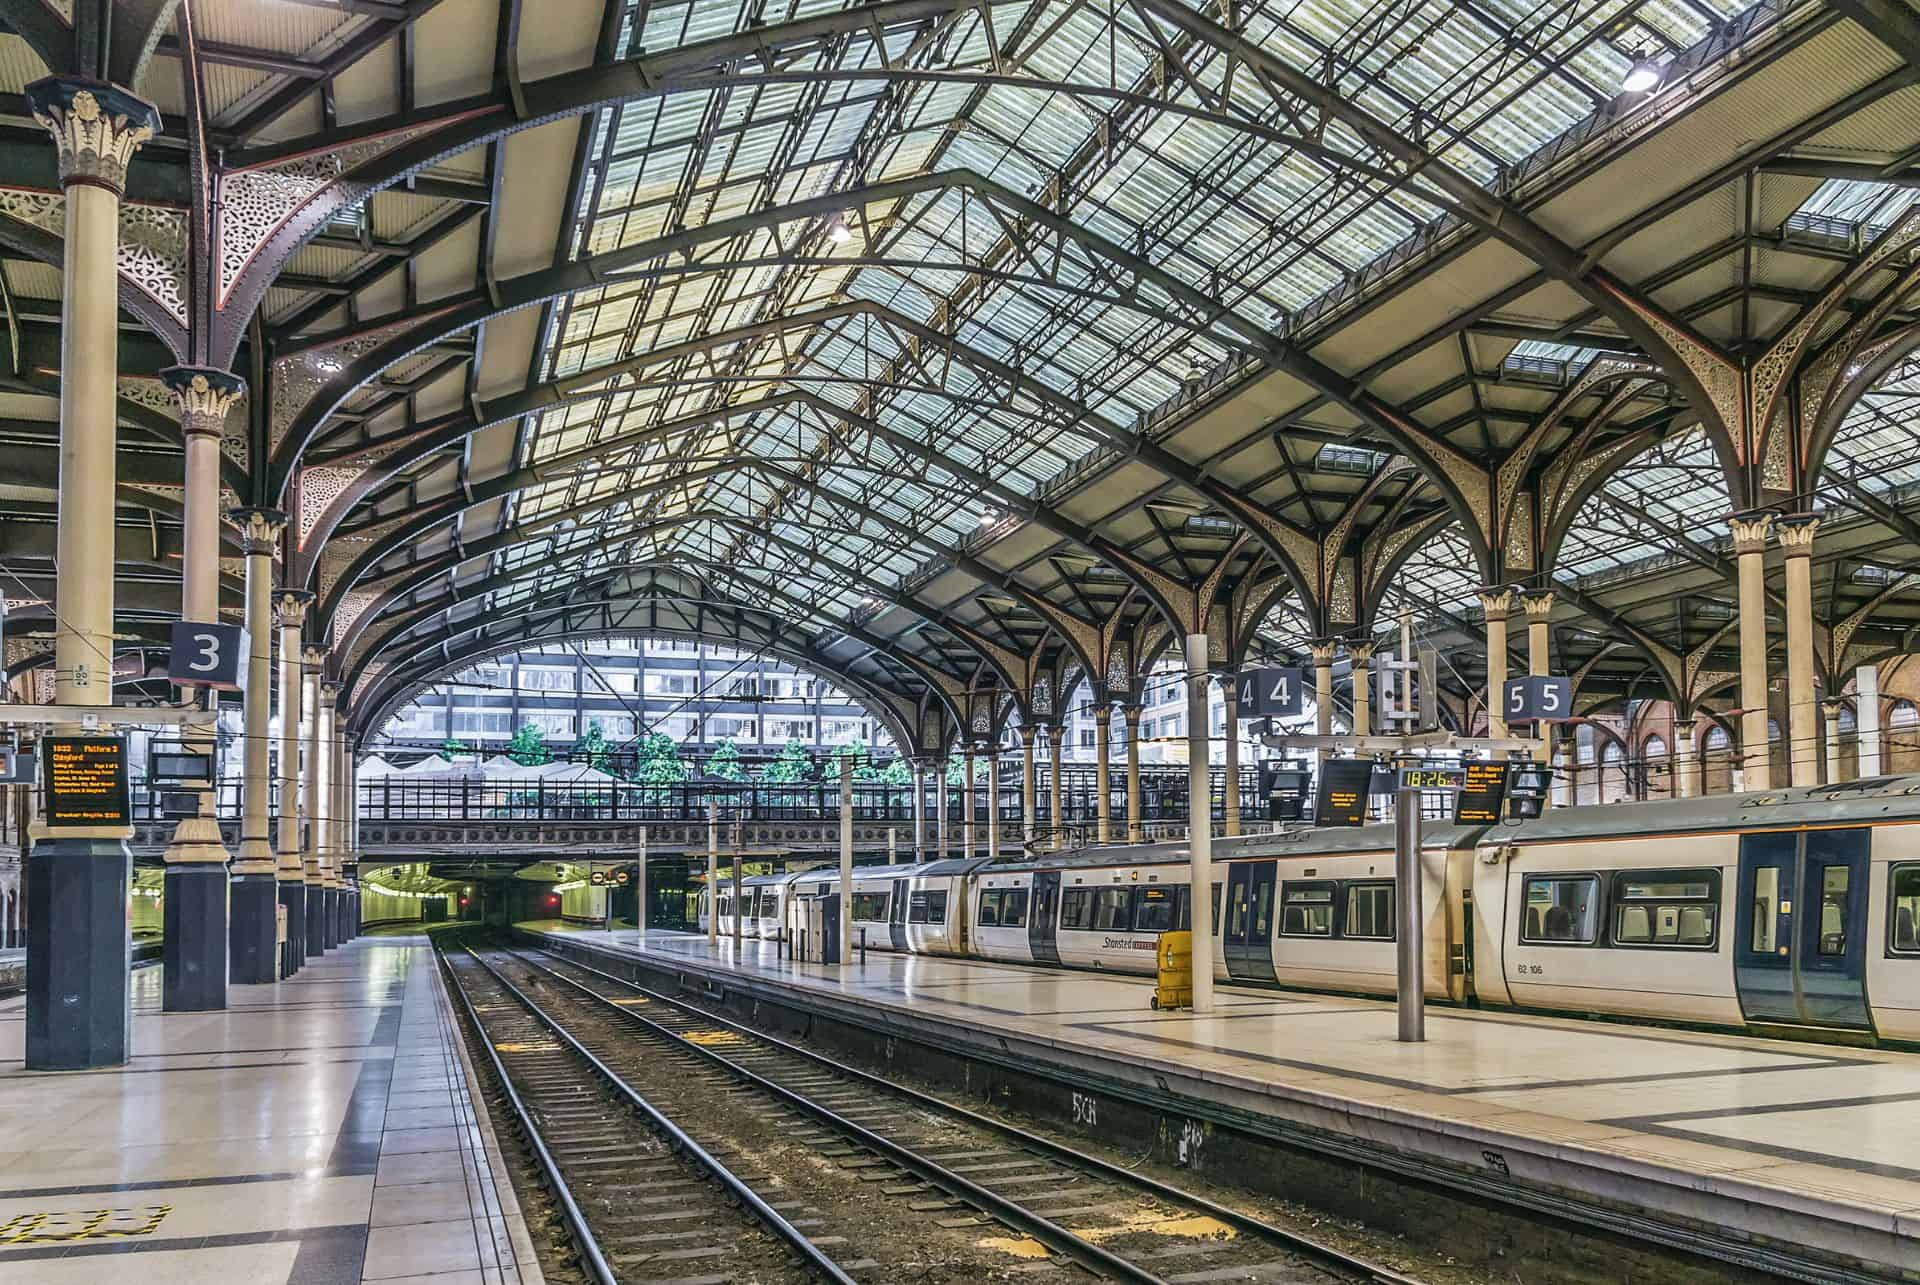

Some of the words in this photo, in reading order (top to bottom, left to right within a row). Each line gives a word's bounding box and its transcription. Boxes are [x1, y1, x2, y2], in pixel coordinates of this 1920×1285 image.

[189, 633, 220, 671] 3
[1241, 679, 1254, 708] 4
[1270, 676, 1291, 706] 4
[1510, 685, 1524, 713] 5
[1543, 684, 1560, 712] 5
[1530, 964, 1543, 974] 106
